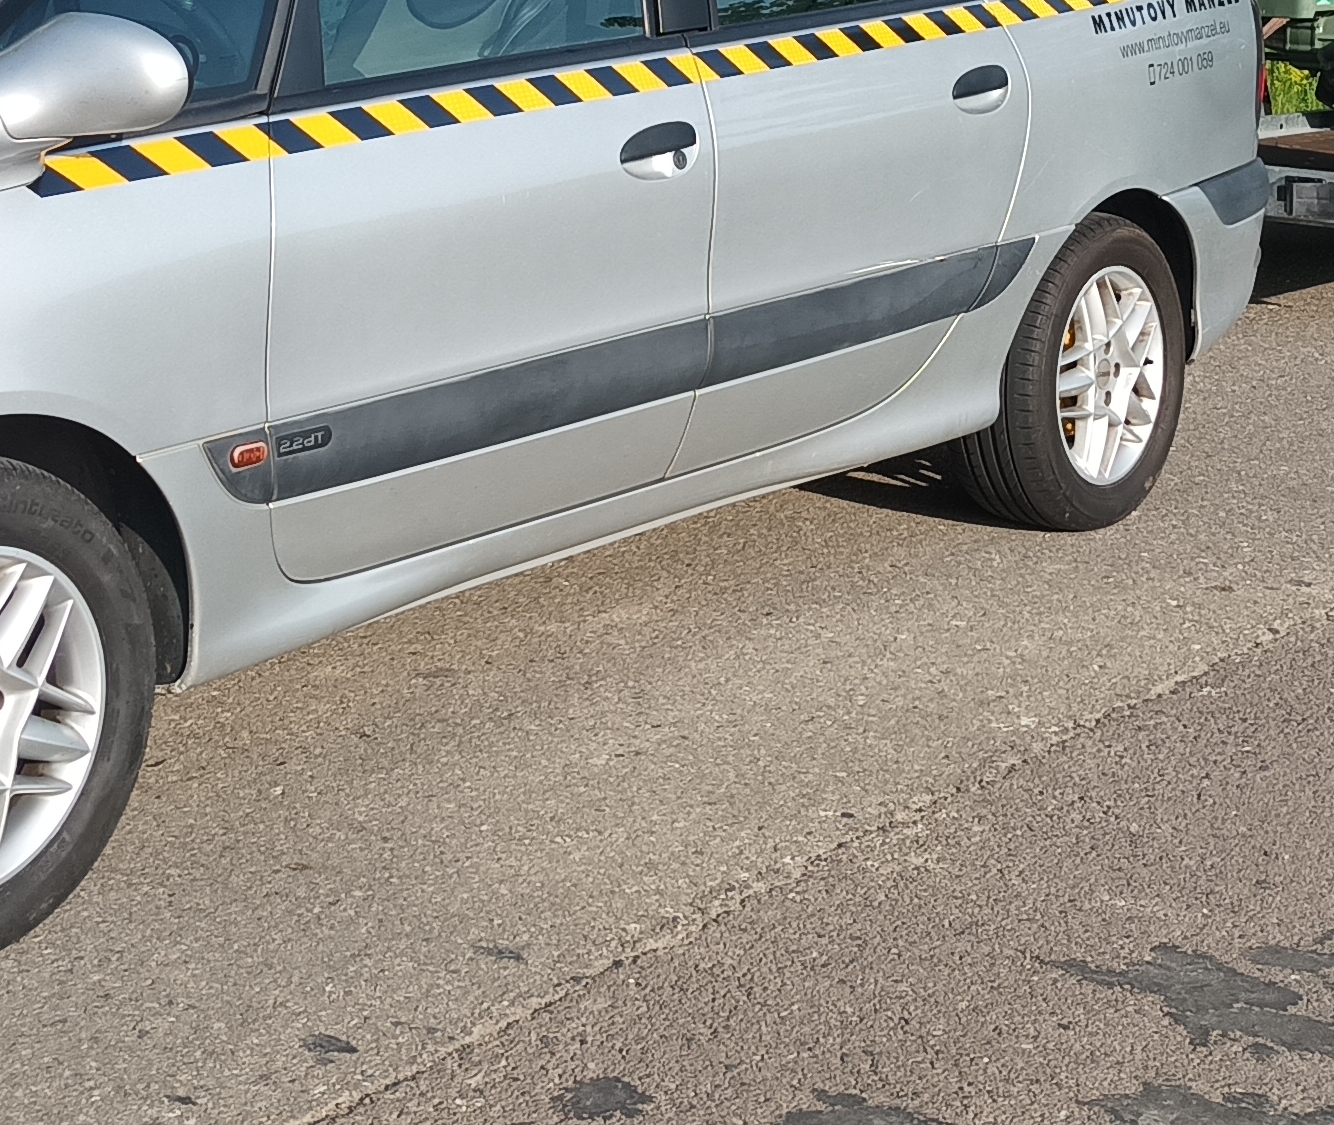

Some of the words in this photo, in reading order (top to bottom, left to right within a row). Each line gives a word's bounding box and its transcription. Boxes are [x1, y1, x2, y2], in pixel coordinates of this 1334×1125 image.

[1119, 19, 1231, 59] www.minutovymanzel.eu
[1157, 61, 1175, 83] 724
[1177, 56, 1194, 76] 001
[1197, 50, 1214, 71] 059
